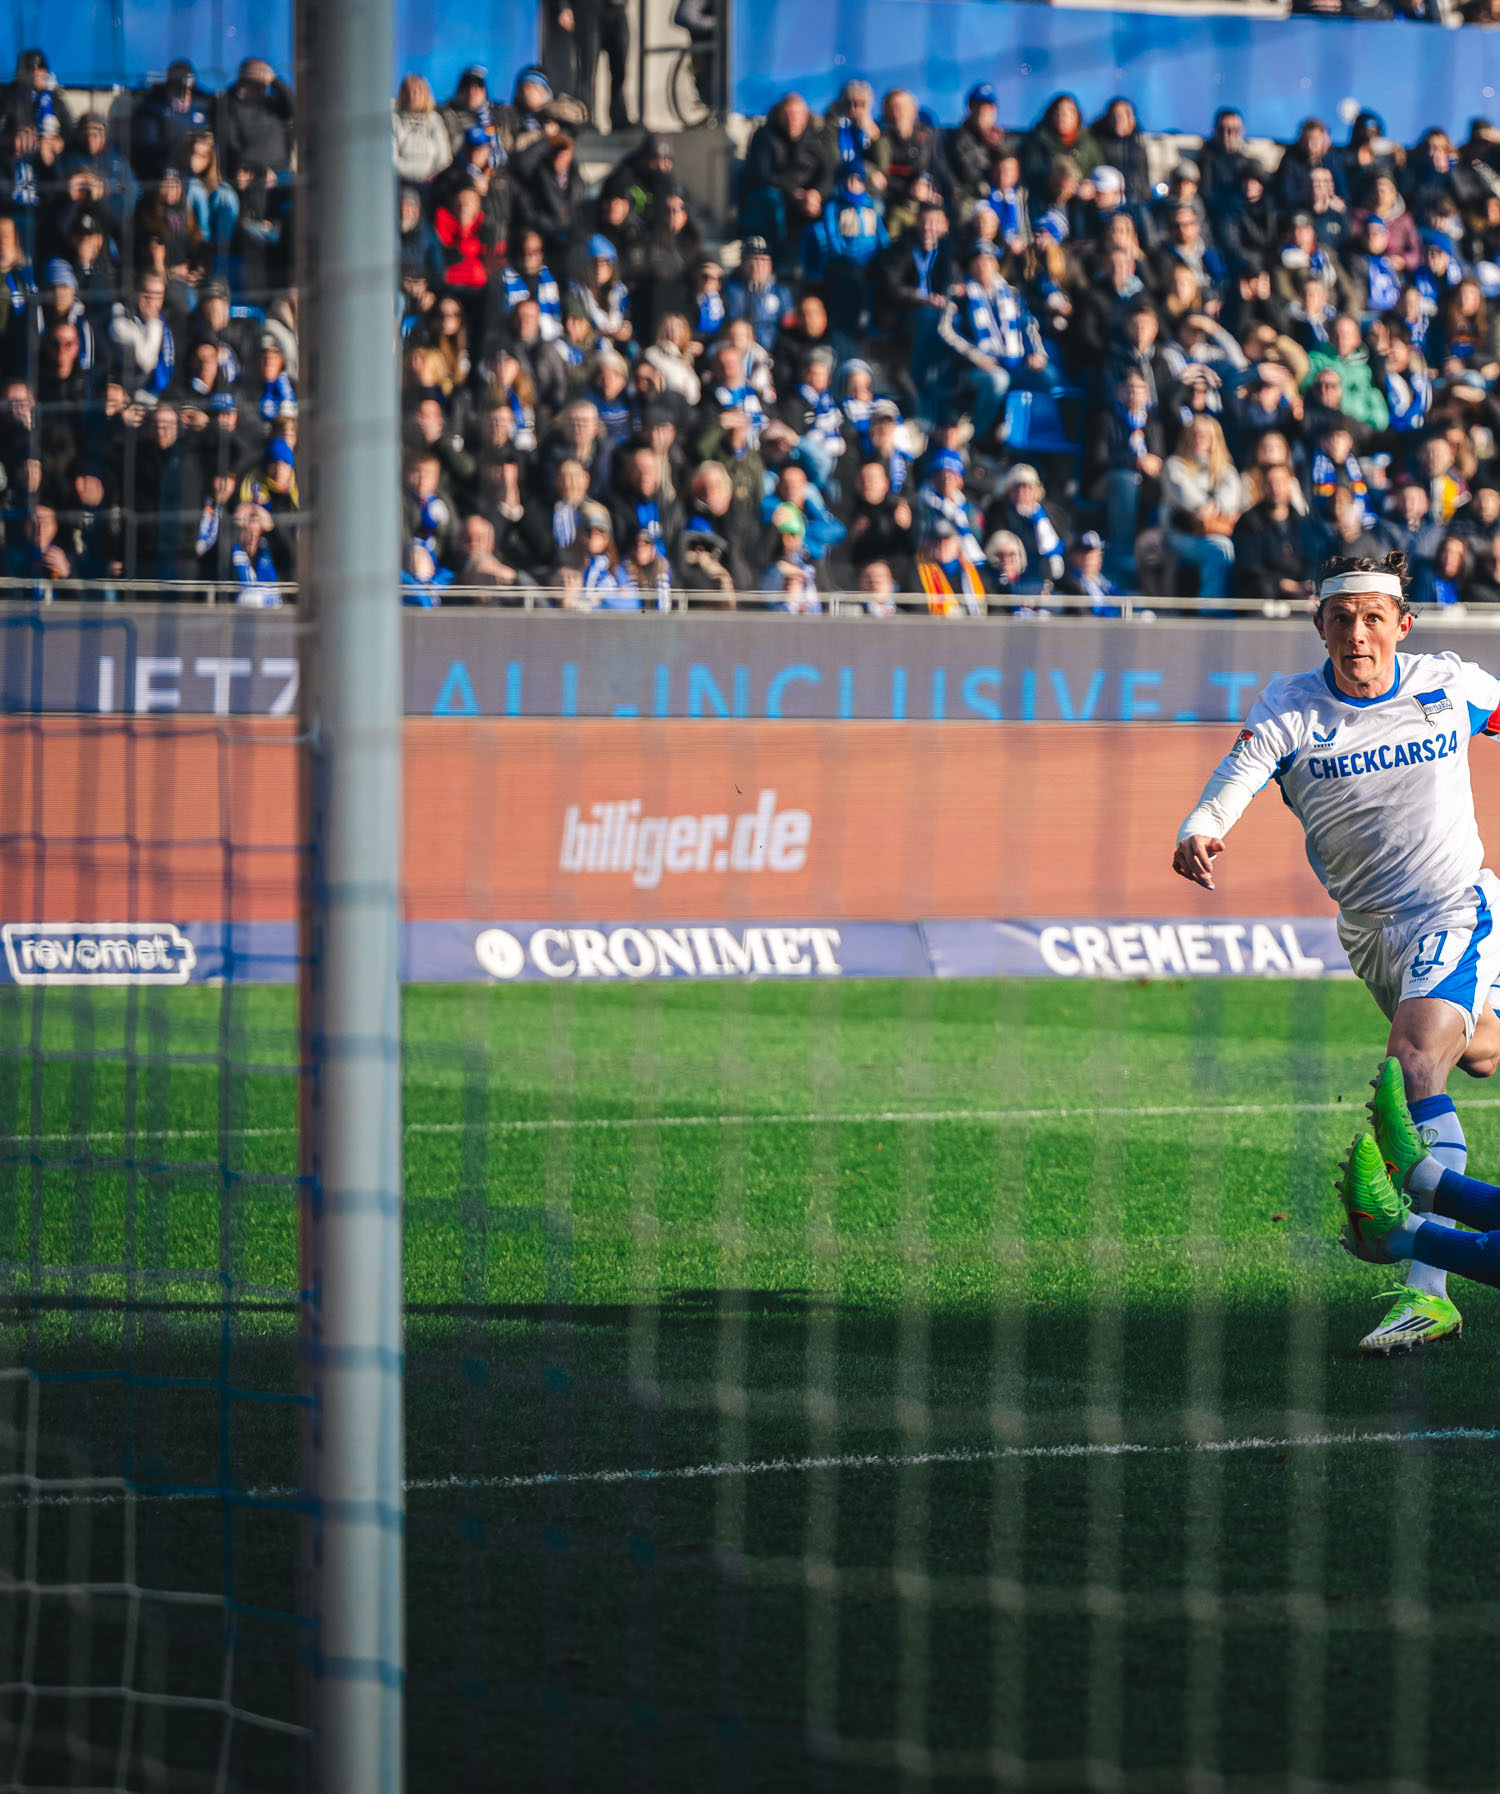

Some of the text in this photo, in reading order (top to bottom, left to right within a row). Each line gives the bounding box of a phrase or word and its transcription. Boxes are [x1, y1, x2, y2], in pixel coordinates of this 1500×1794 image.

[1308, 730, 1459, 780] CHECKCARS24
[558, 788, 812, 890] billiger.de
[21, 933, 175, 970] revomet
[529, 928, 843, 978] CRONIMET
[1040, 923, 1326, 976] CREMETAL
